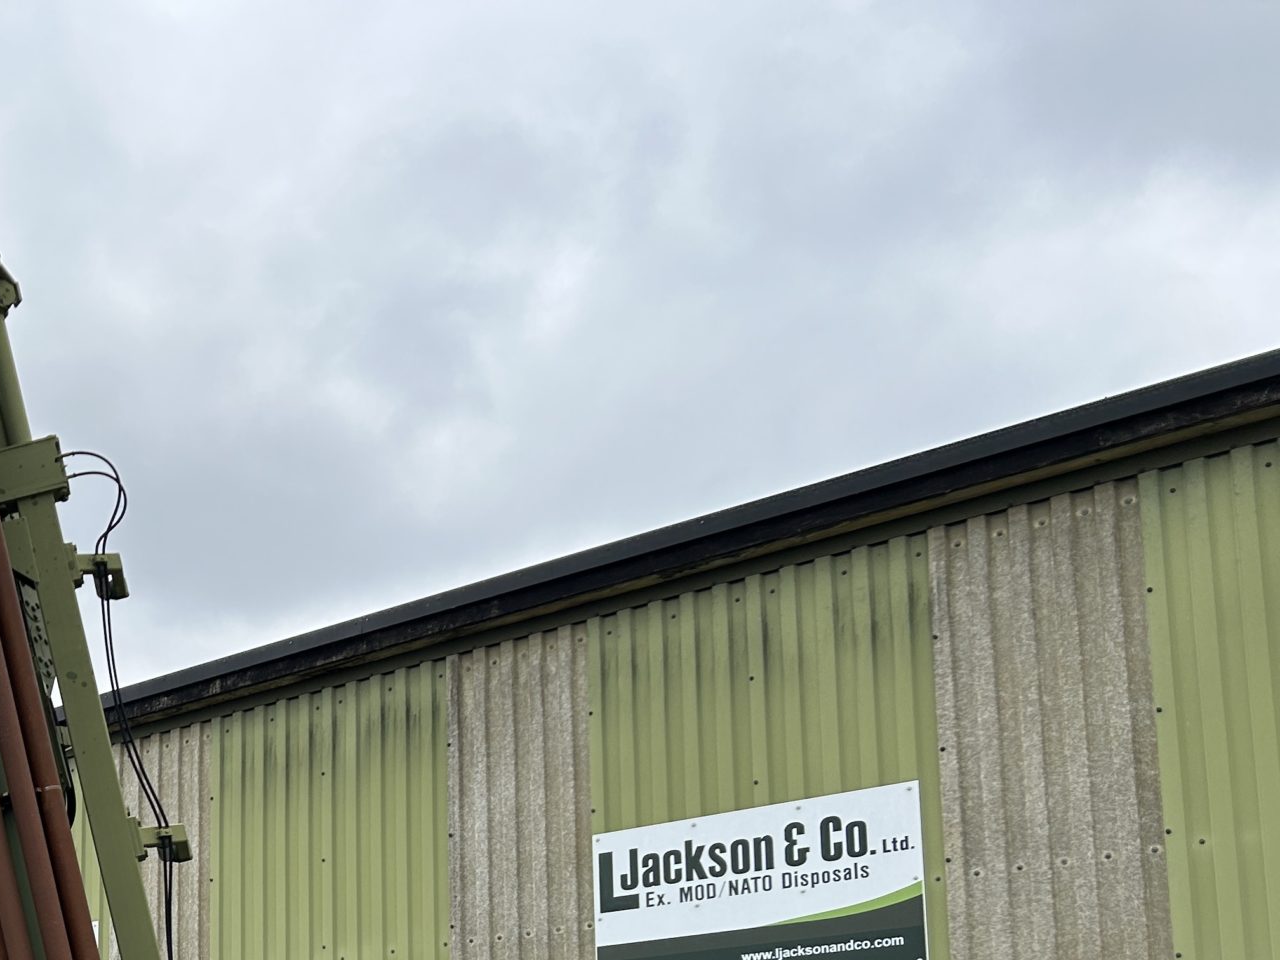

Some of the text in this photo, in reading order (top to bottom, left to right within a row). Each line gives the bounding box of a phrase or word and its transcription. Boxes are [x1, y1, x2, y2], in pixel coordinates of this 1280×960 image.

[784, 821, 810, 867] &
[820, 815, 877, 862] Co.
[882, 835, 915, 854] Ltd.
[645, 891, 671, 908] Ex.
[782, 862, 870, 889] Disposals
